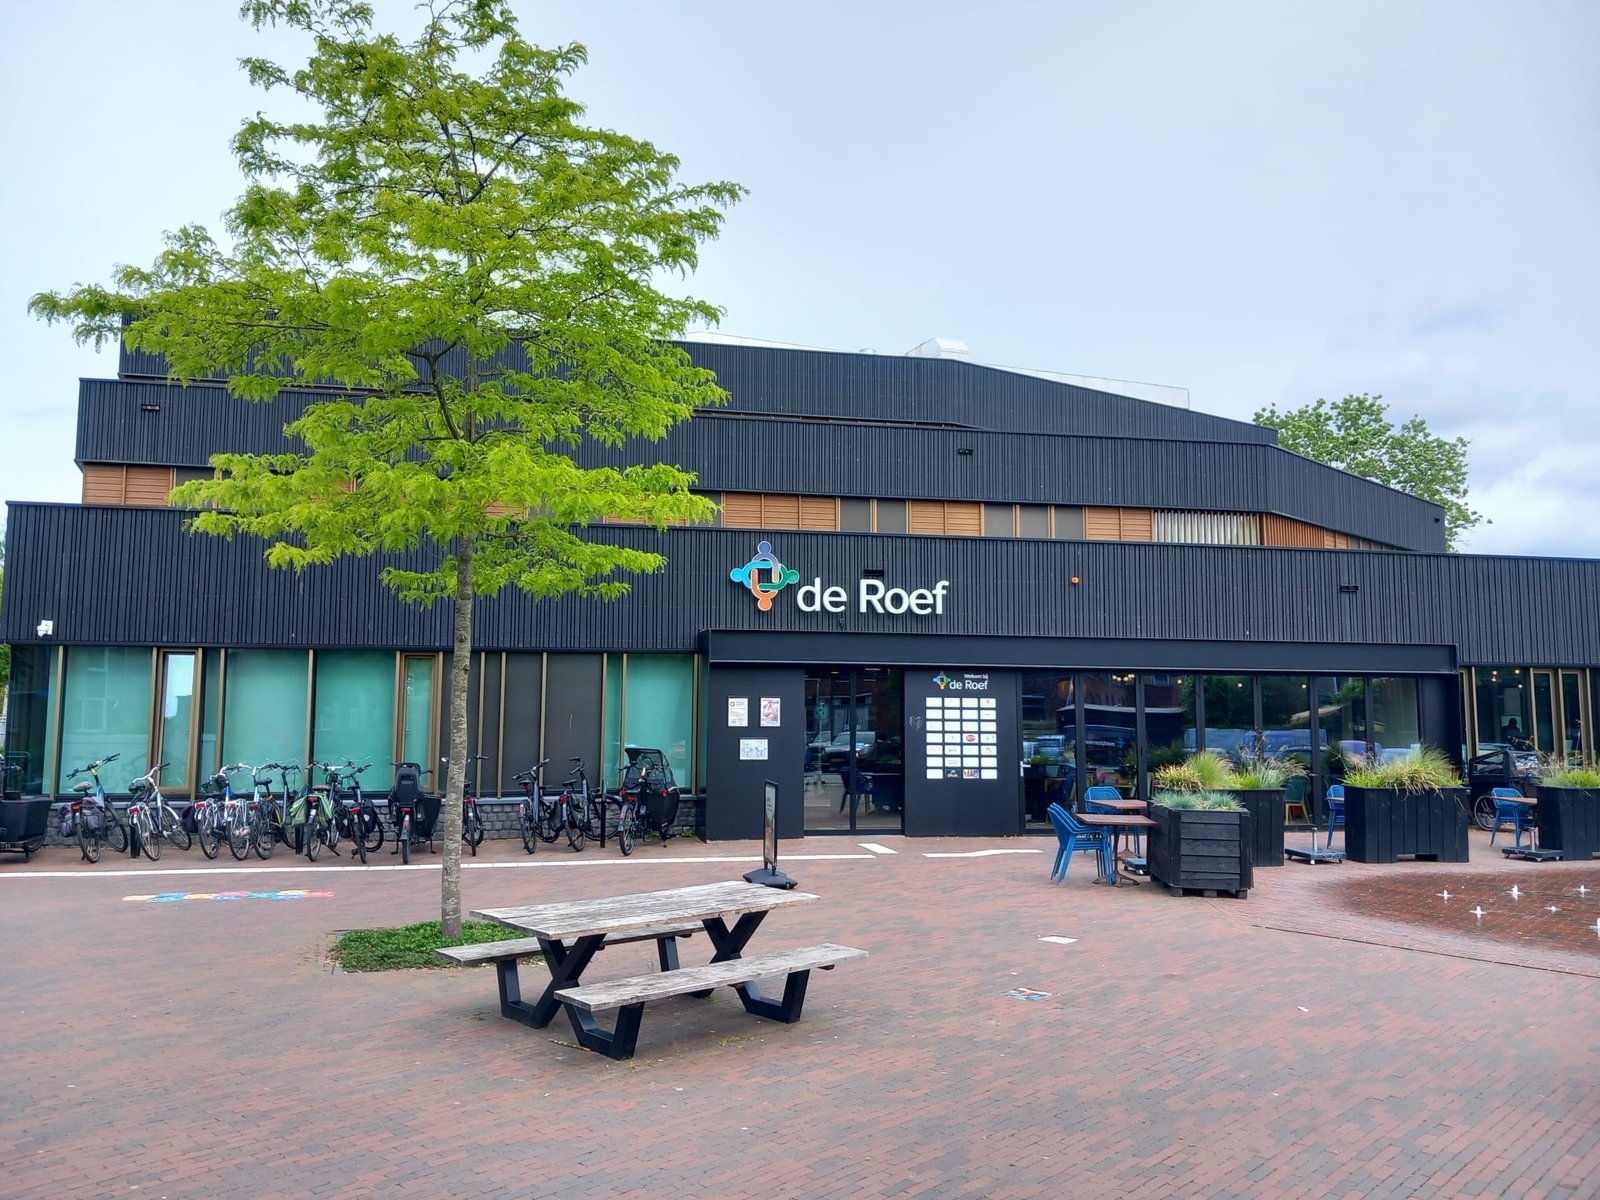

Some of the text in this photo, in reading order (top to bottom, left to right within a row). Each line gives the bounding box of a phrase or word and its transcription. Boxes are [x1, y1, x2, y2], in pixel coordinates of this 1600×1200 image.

[797, 577, 949, 615] de Roef
[949, 680, 988, 690] de Roef
